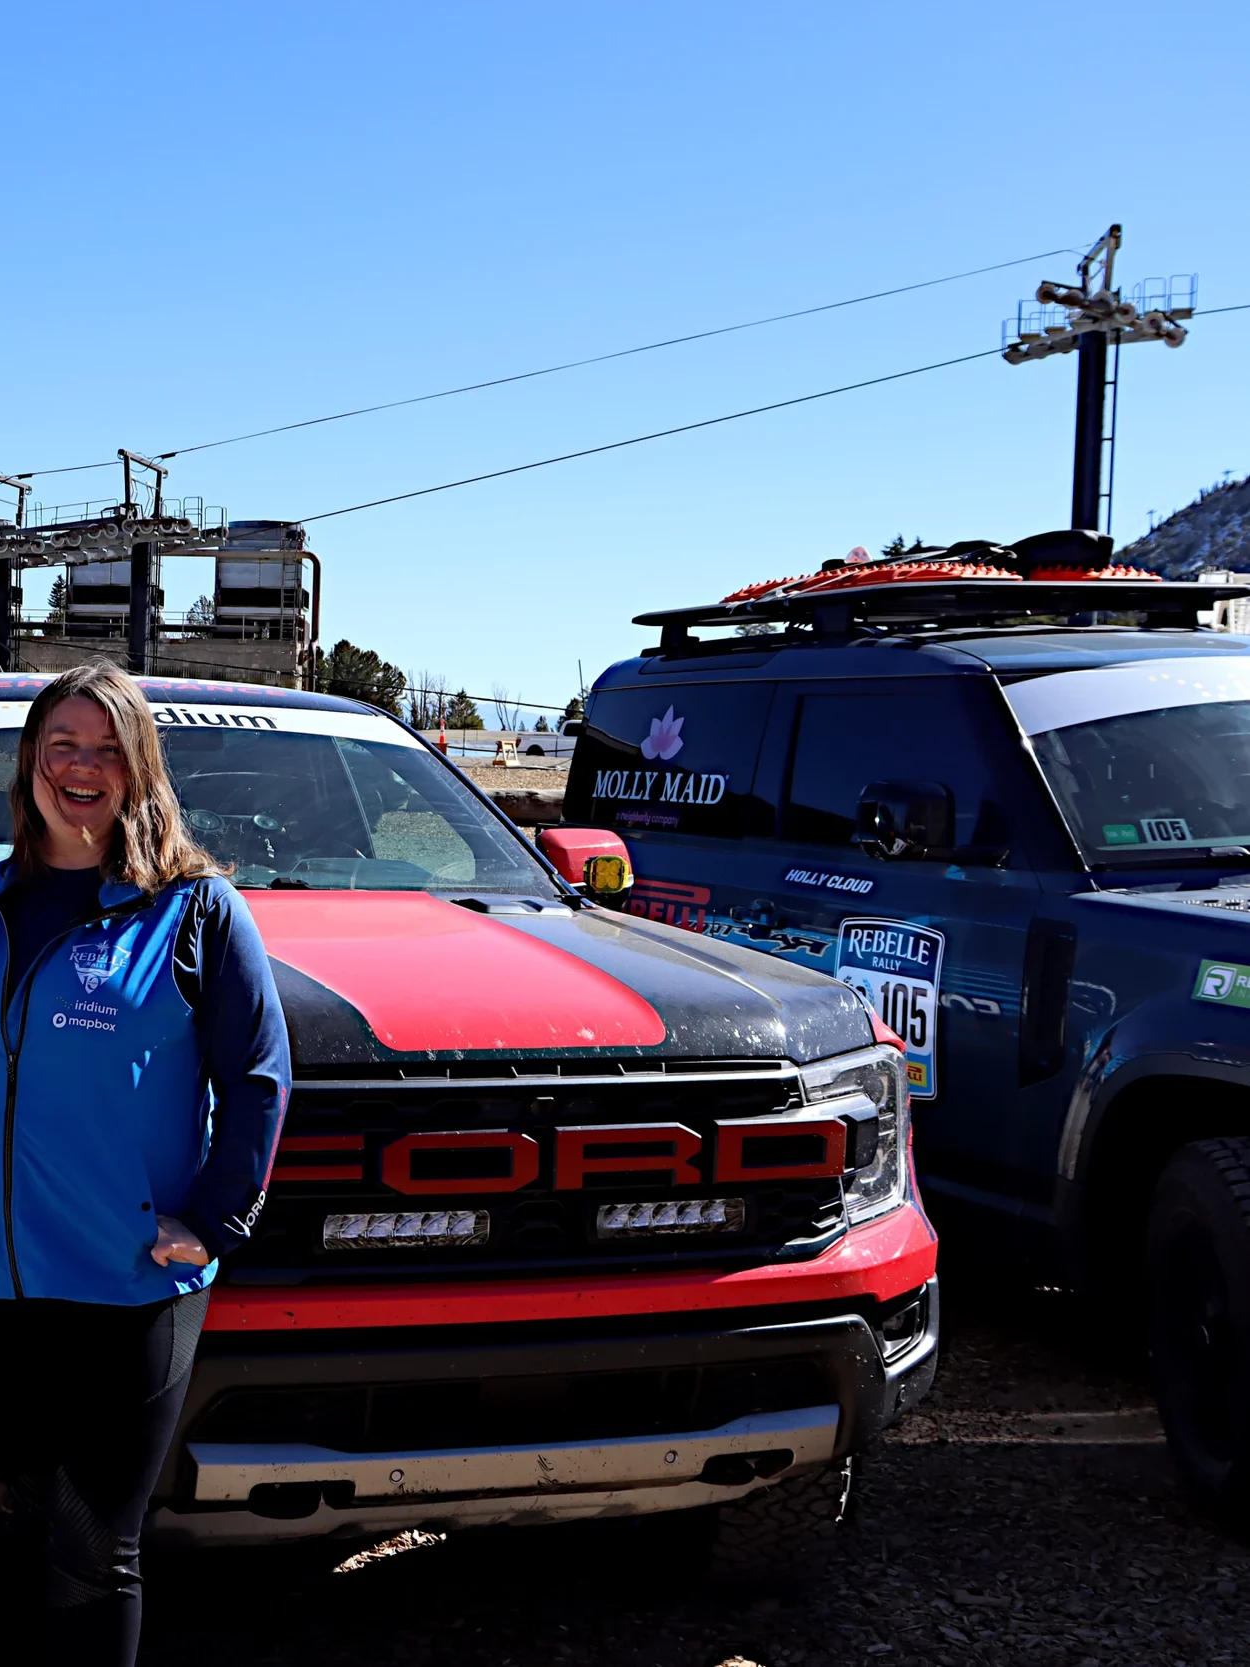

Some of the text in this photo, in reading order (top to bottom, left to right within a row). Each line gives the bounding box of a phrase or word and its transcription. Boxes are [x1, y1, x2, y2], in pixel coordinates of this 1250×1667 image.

[152, 706, 278, 730] dium
[591, 770, 726, 805] MOLLY MAID
[1146, 820, 1188, 842] 105
[784, 868, 874, 894] HOLLY CLOUD
[848, 927, 931, 967] REBELLE
[69, 952, 129, 968] REBELLE
[872, 956, 902, 972] RALLY
[74, 999, 117, 1016] iridium
[880, 980, 929, 1048] 105
[68, 1016, 116, 1032] mapbox
